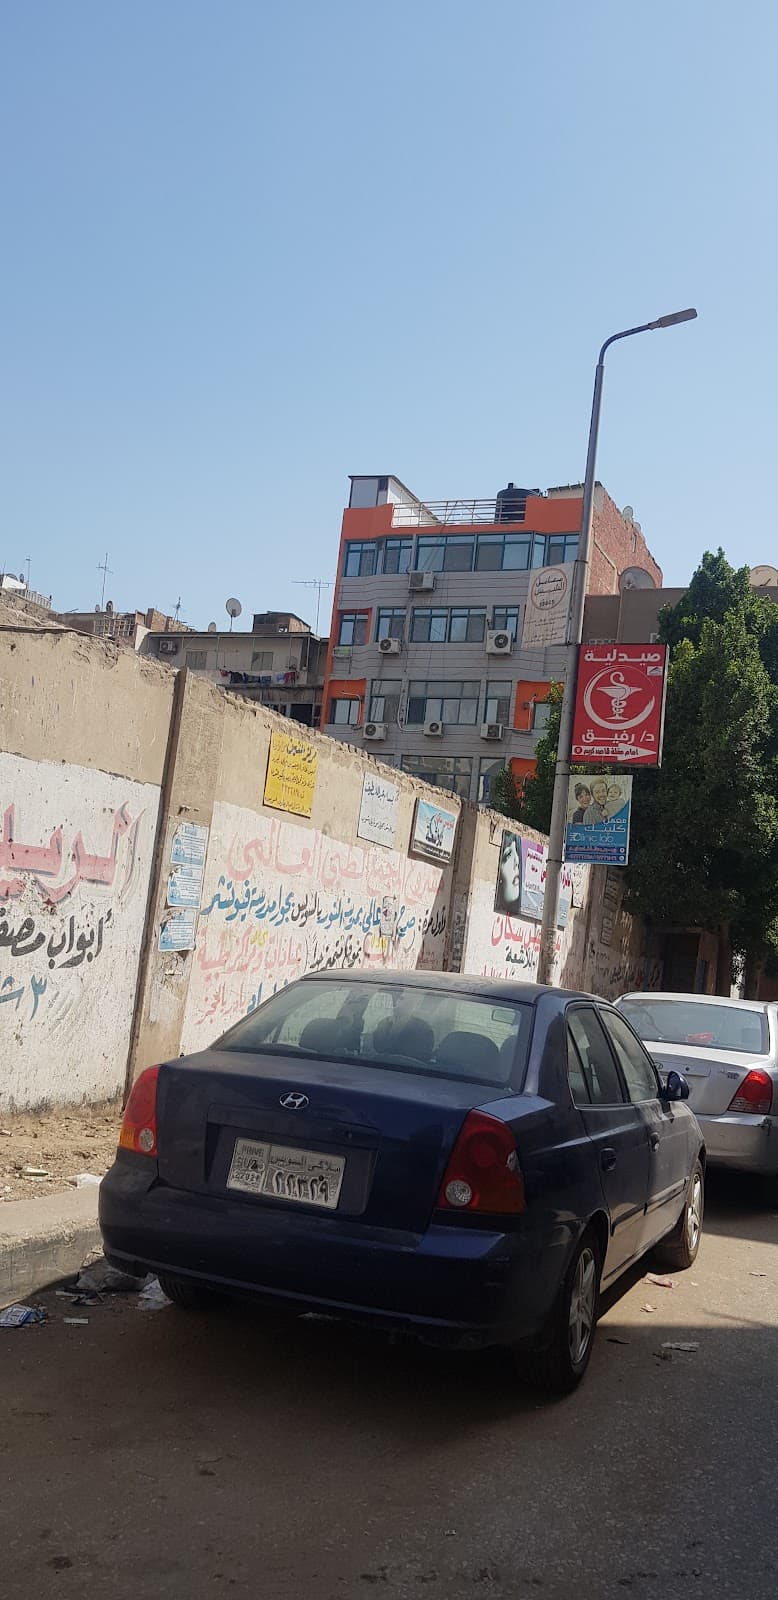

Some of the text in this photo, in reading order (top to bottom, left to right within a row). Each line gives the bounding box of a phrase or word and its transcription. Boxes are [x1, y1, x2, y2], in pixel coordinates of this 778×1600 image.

[584, 648, 661, 665] صيدلية
[582, 729, 635, 744] رفيق
[46, 907, 113, 969] أبواب
